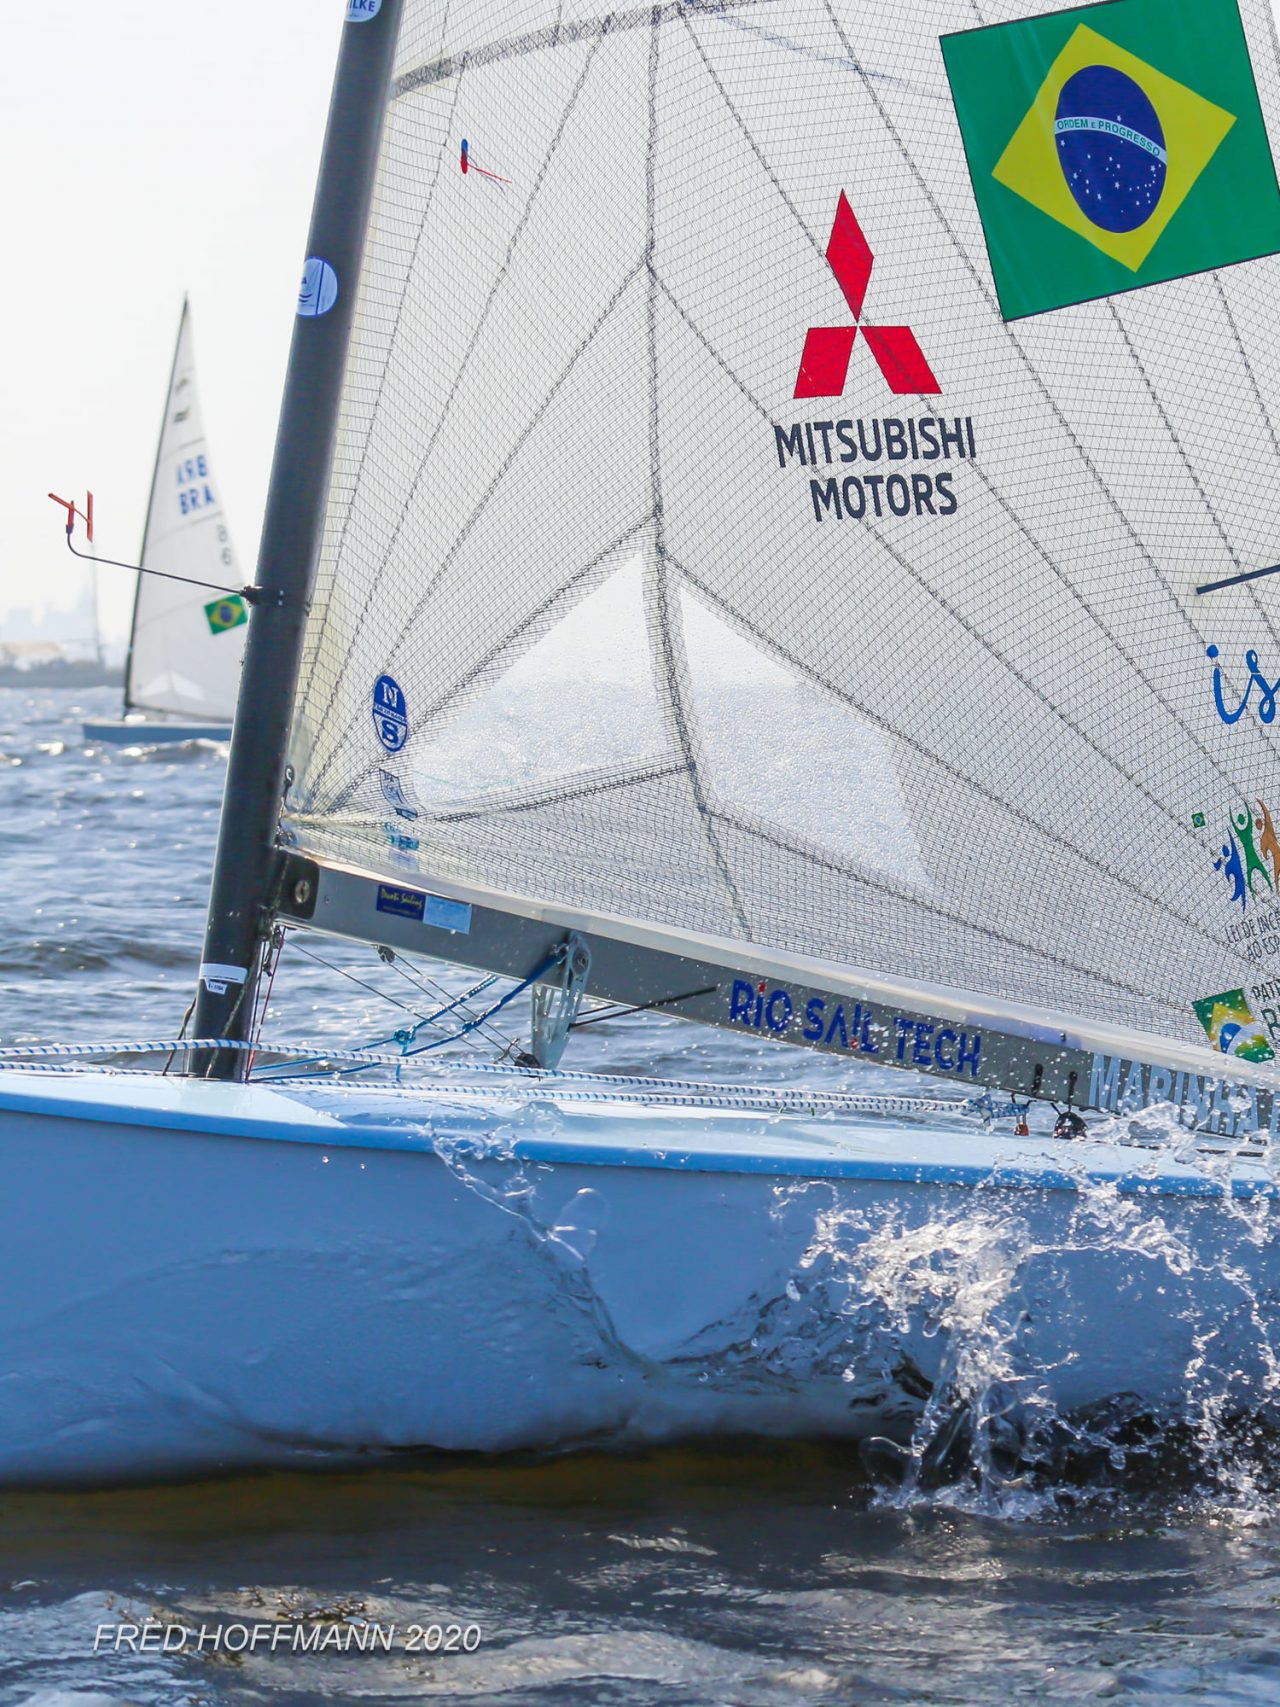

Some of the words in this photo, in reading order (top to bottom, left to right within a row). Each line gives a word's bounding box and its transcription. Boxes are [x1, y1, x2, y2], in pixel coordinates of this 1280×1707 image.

[1057, 118, 1089, 130] ORDEM
[1098, 120, 1160, 157] PROGRESSO
[773, 416, 977, 468] MITSUBISHI
[179, 485, 215, 515] BRA
[809, 472, 958, 522] MOTORS
[1224, 924, 1241, 944] LEI
[1240, 918, 1258, 938] DE
[1246, 940, 1263, 961] AO
[729, 979, 792, 1033] RIO
[893, 1015, 981, 1077] TECH
[1088, 1053, 1261, 1139] MARINHA
